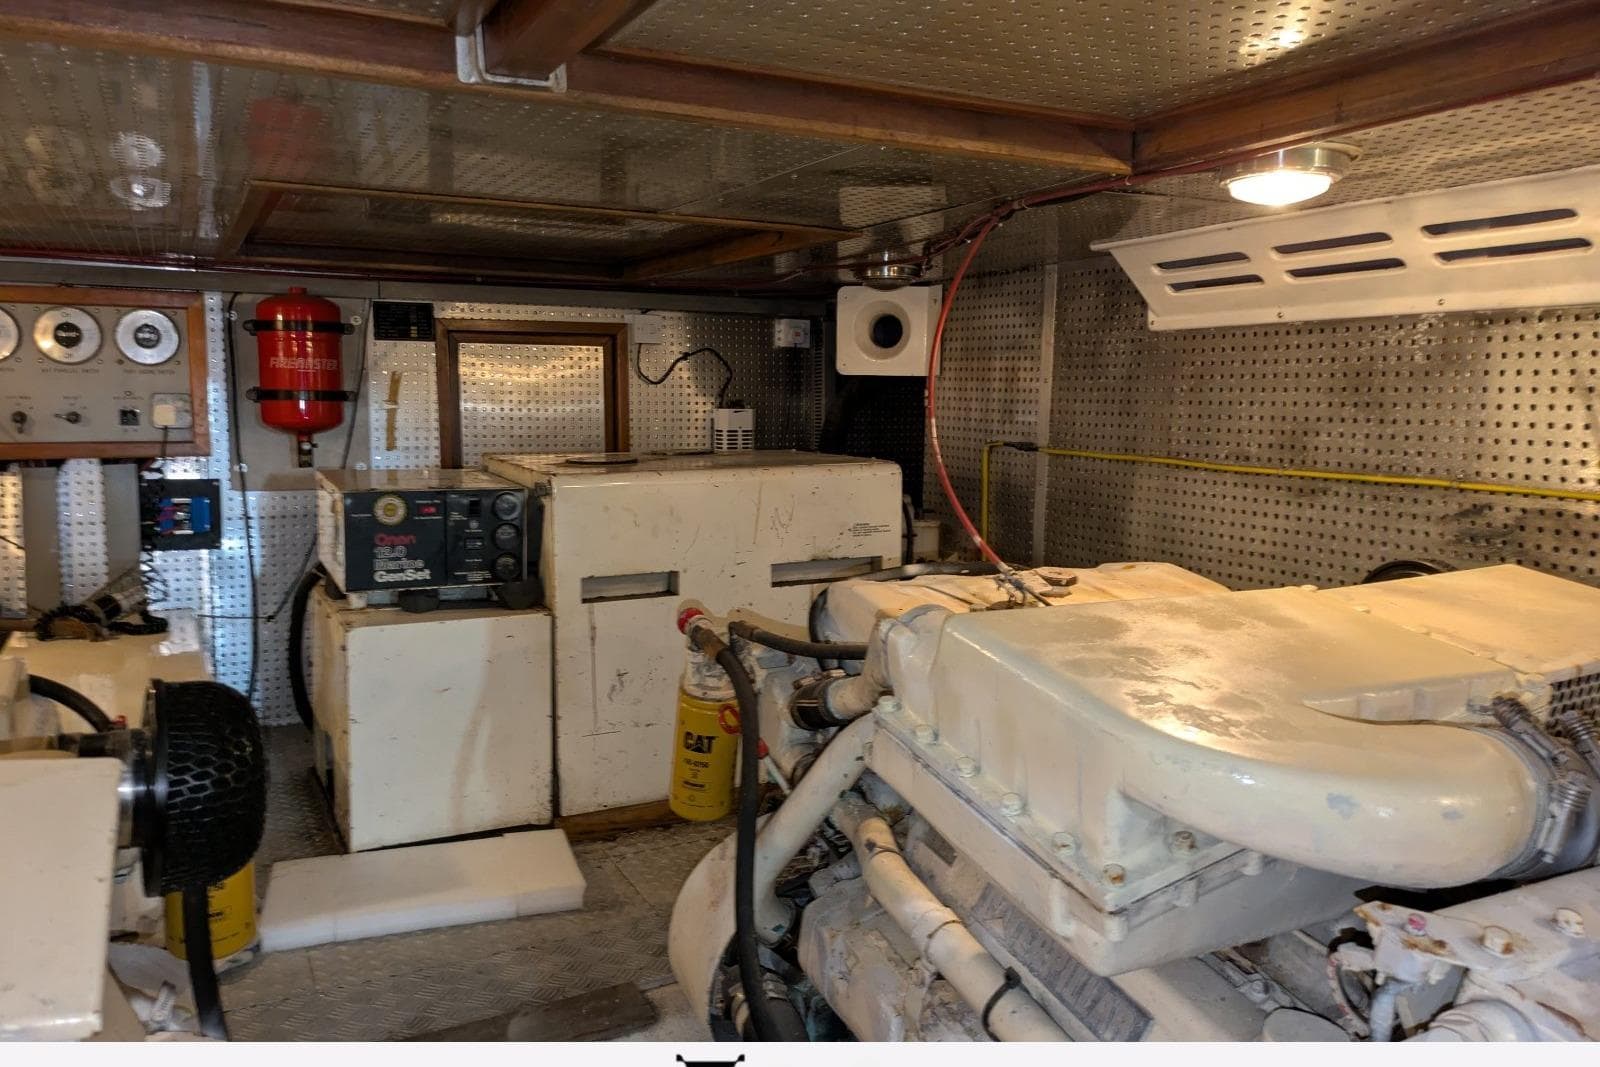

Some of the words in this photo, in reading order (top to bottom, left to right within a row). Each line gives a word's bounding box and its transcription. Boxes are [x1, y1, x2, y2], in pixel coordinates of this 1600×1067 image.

[270, 357, 338, 370] FIREMASTER
[373, 557, 425, 570] Marine
[373, 568, 432, 583] GenSet
[684, 731, 719, 754] CAT
